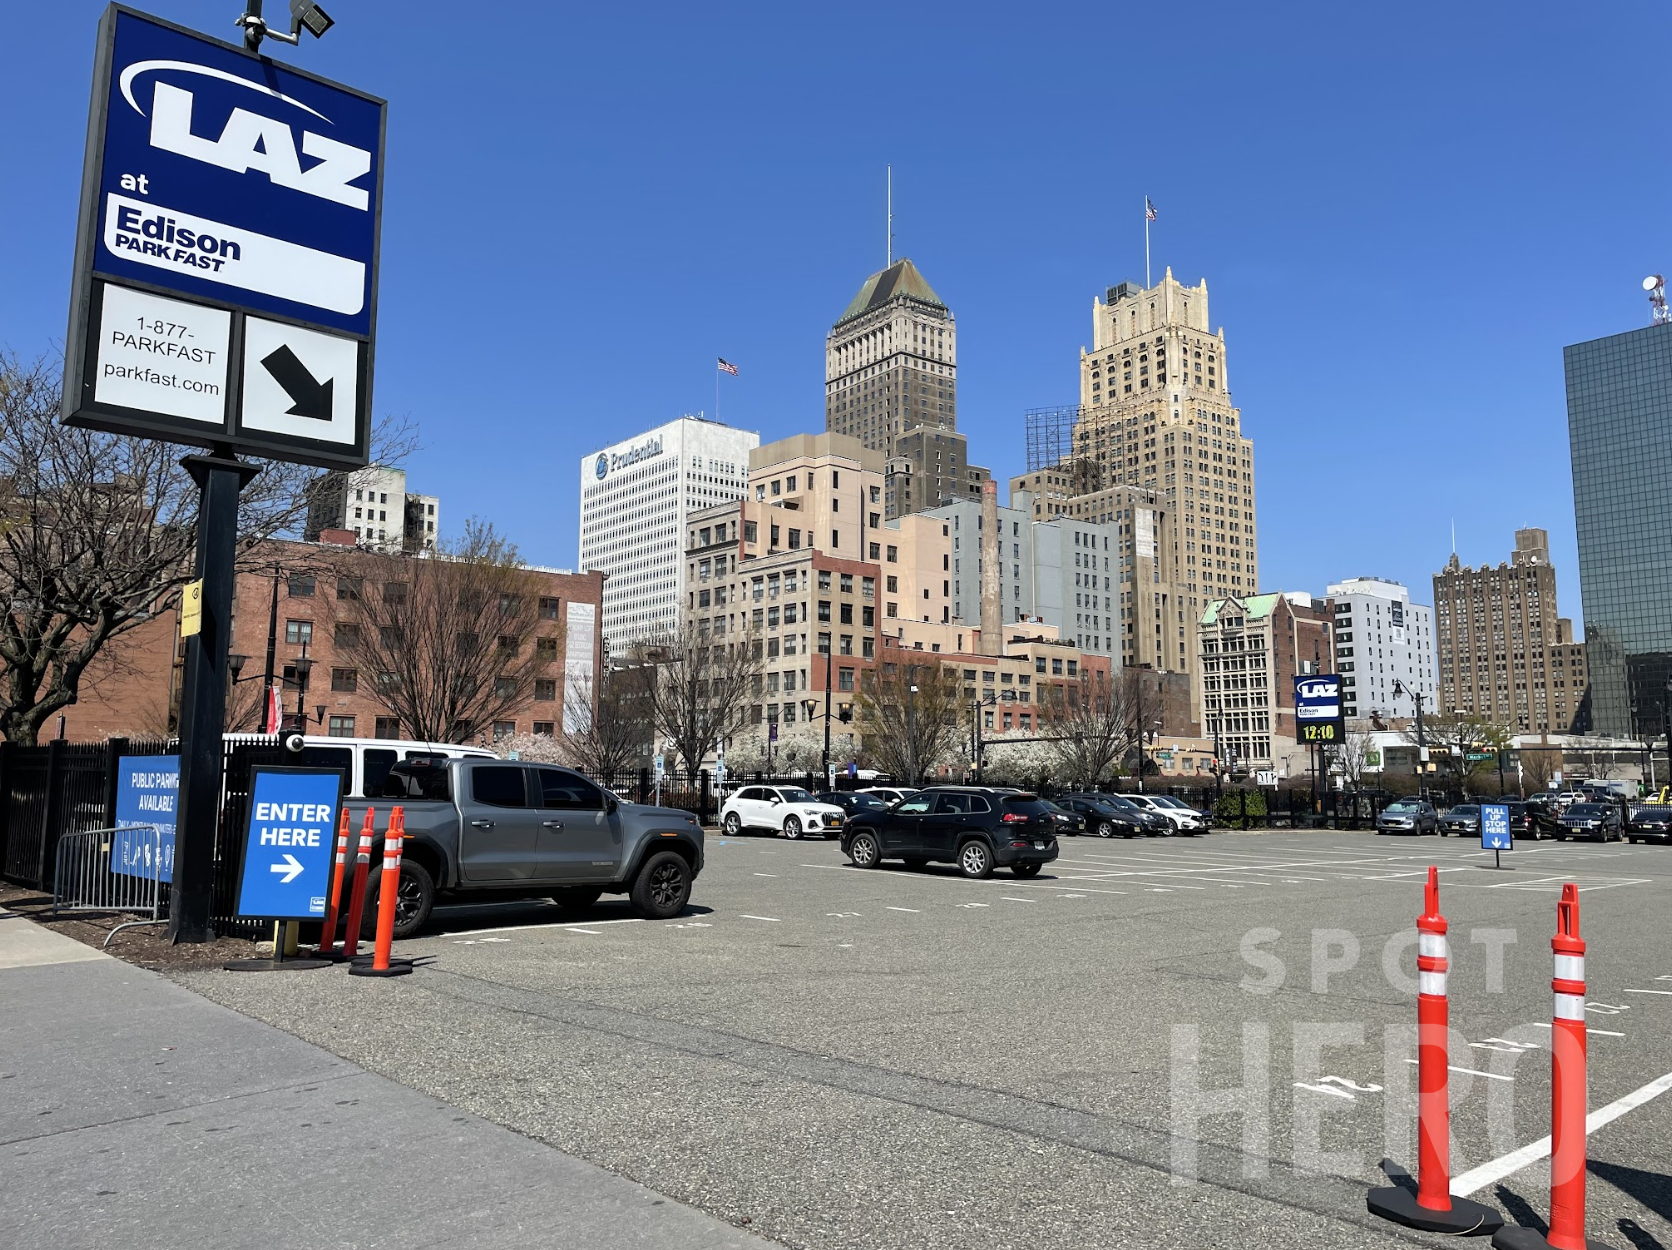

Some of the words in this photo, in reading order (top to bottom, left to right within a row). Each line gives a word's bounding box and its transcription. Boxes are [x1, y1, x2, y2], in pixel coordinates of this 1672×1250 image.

[150, 81, 372, 212] LAZ
[120, 173, 149, 195] at
[116, 204, 241, 261] Edison
[137, 316, 195, 339] 1-877-
[112, 330, 216, 365] PARKFAST
[104, 363, 219, 395] parkfast.com
[610, 434, 664, 472] Prudential
[1301, 684, 1338, 698] LAZ
[1303, 725, 1334, 740] 12:10
[131, 772, 155, 789] PUBLIC
[138, 794, 174, 812] AVAILABLE
[255, 802, 331, 824] ENTER
[1485, 807, 1506, 815] PULL
[1484, 820, 1507, 828] STOP
[260, 827, 321, 847] HERE
